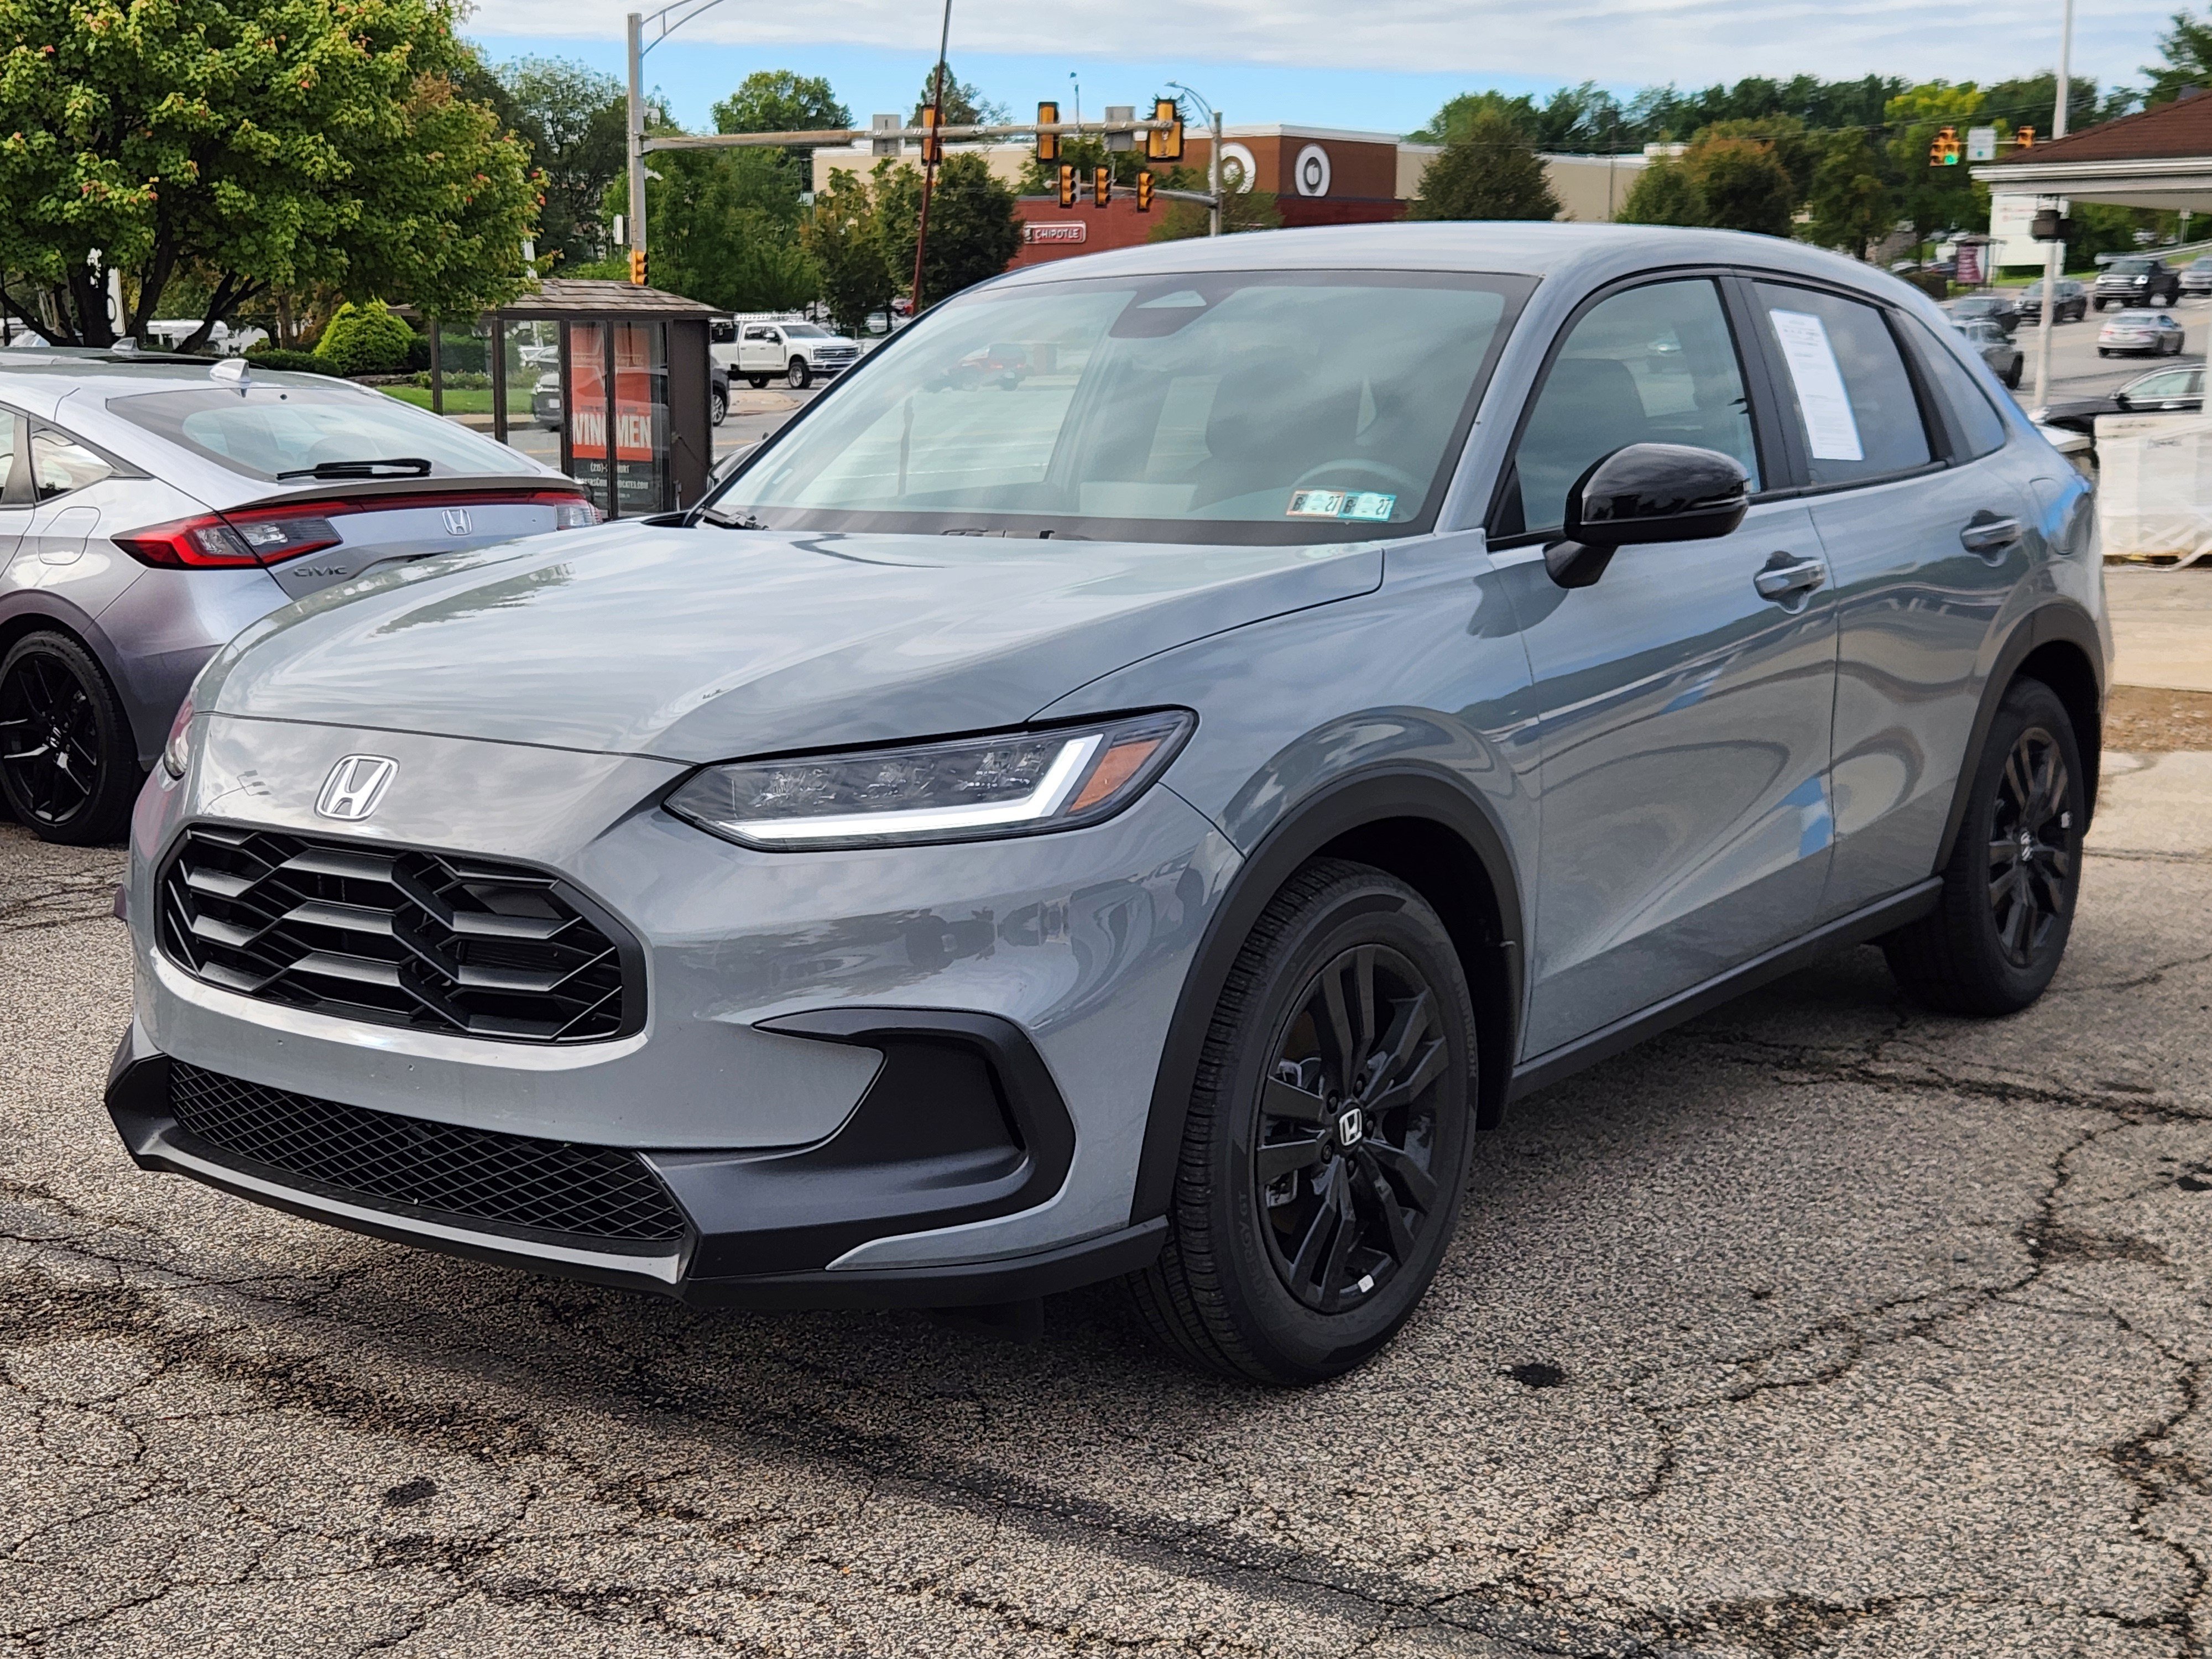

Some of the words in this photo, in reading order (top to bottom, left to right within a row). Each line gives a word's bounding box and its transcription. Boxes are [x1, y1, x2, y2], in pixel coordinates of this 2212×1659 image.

[1035, 228, 1079, 239] CHIPOTLE
[1325, 495, 1340, 512] 27
[1375, 499, 1391, 515] 27
[293, 565, 347, 577] CIVIC
